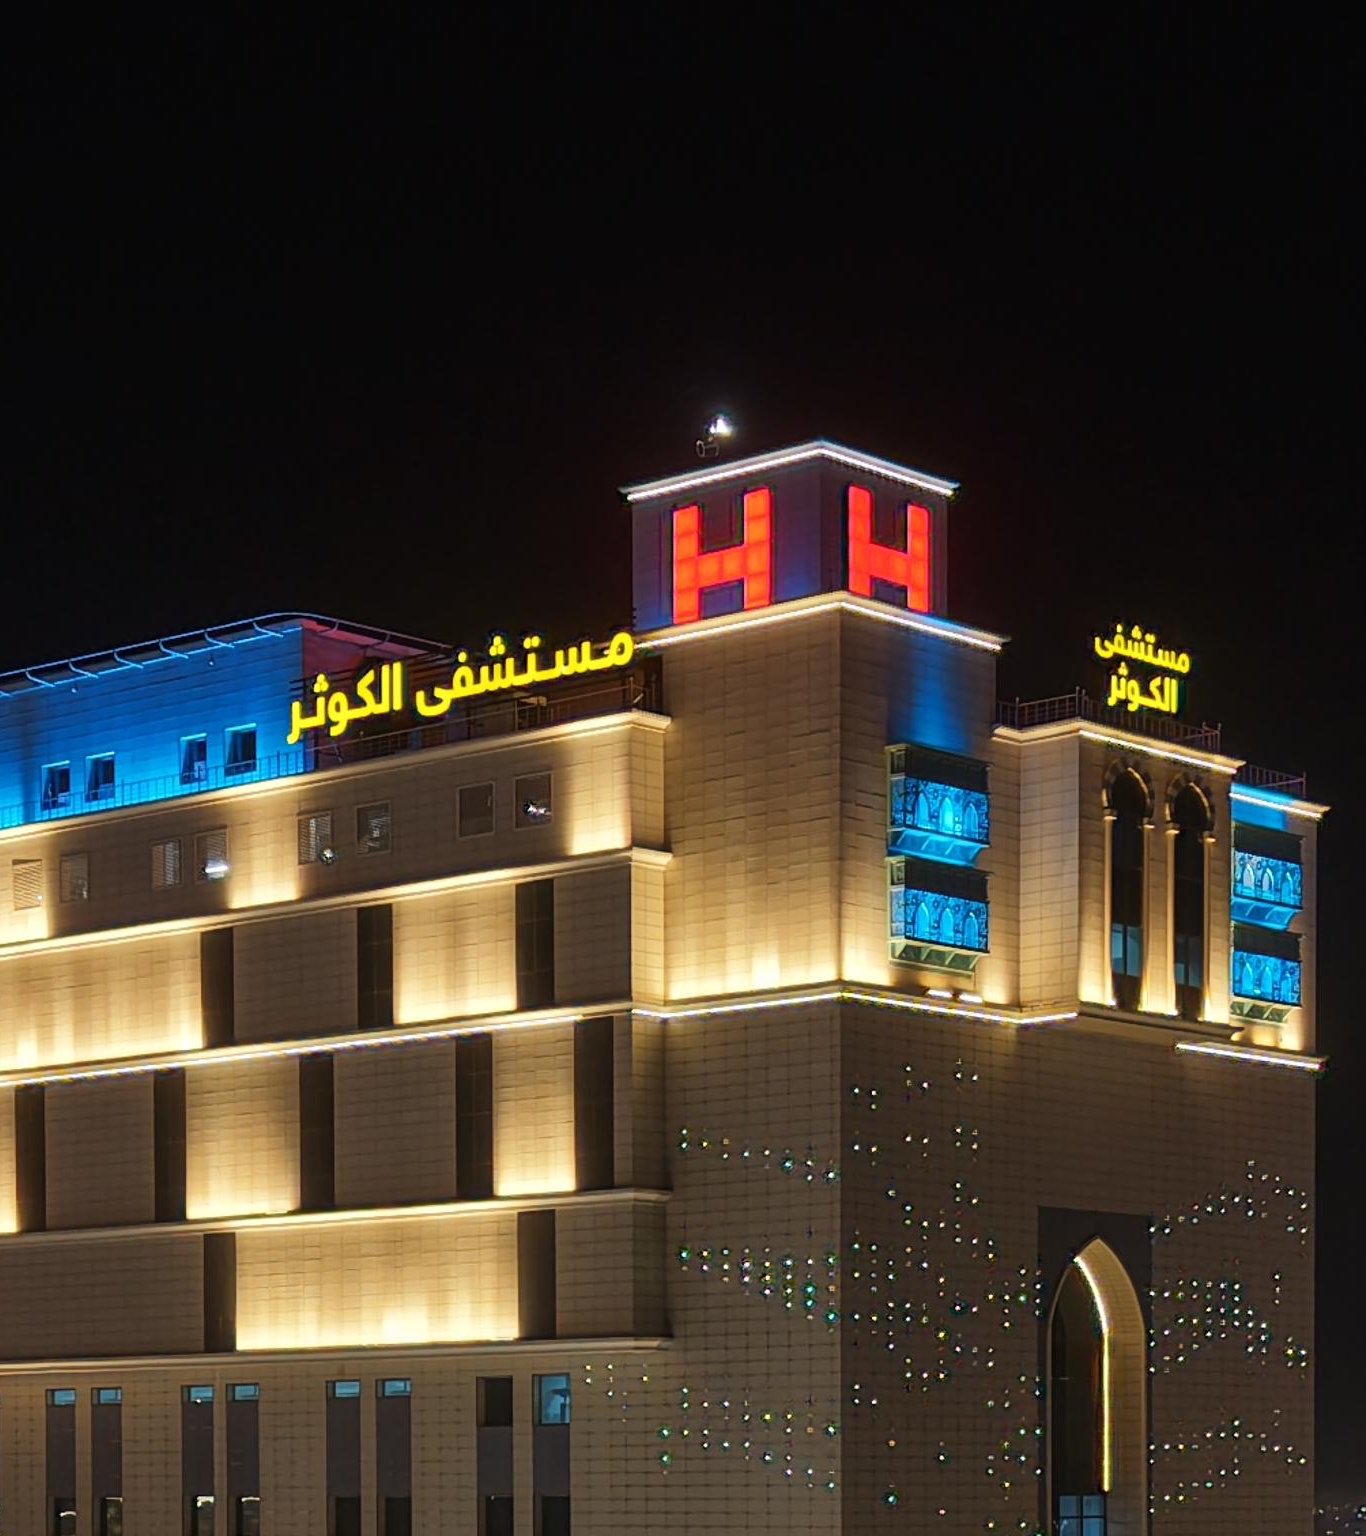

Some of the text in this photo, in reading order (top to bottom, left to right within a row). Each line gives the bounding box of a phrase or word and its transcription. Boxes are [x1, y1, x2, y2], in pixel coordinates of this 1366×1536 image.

[673, 486, 772, 624] H
[848, 484, 930, 614] H
[286, 631, 634, 745] مستشفى الكوثر
[1095, 624, 1190, 673] مستشفى
[1107, 661, 1178, 713] الكوثر
